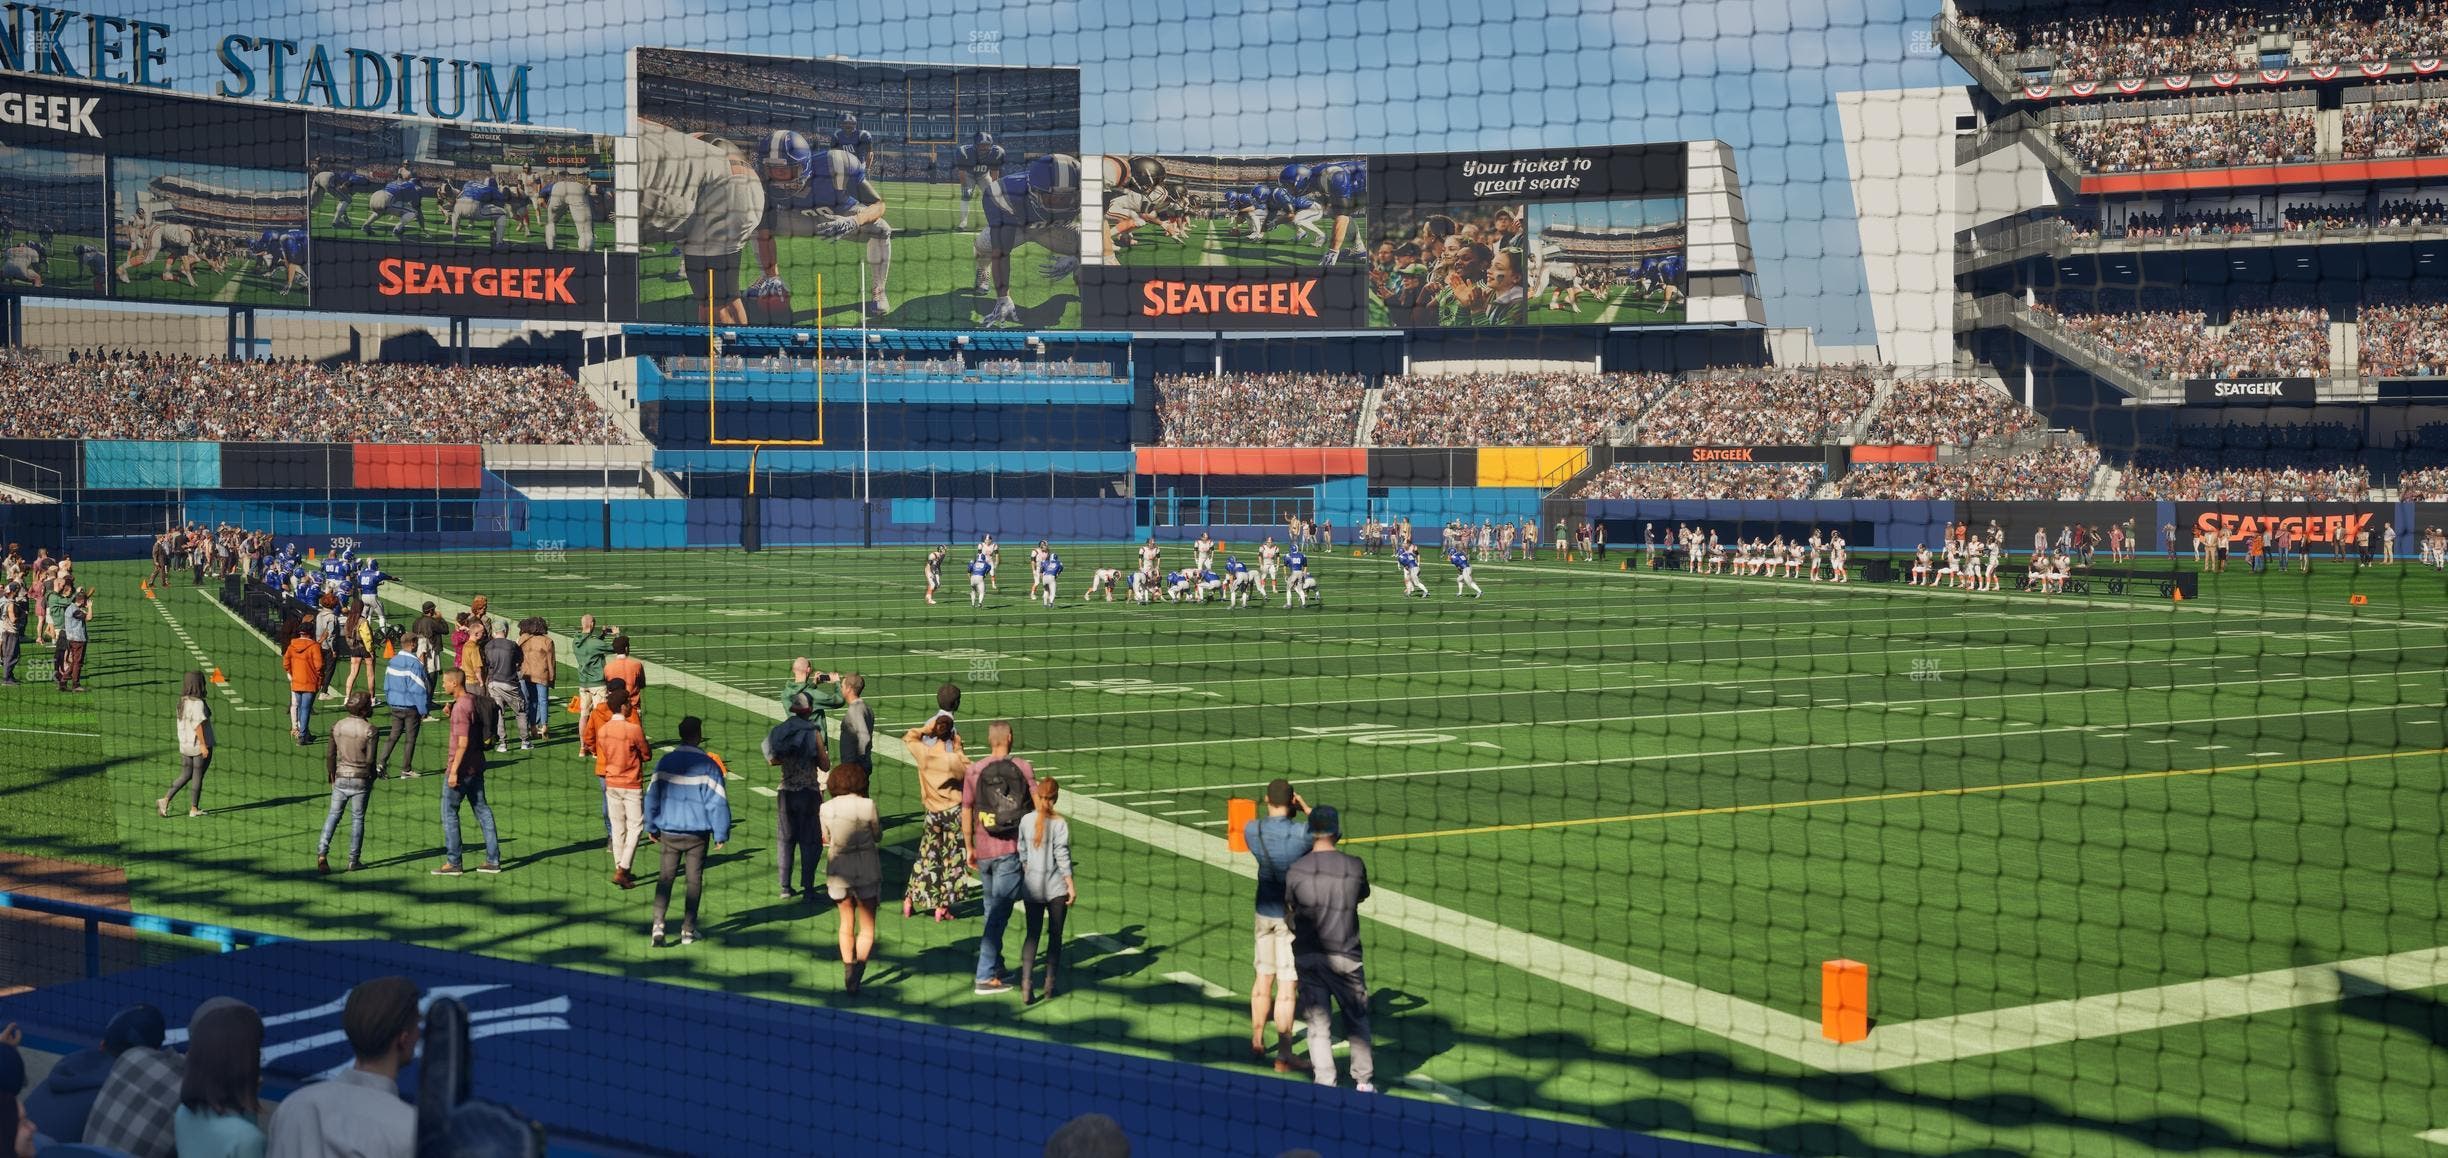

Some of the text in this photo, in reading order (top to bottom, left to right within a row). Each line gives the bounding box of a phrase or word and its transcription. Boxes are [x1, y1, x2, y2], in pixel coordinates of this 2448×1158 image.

[216, 34, 535, 124] STADIUM
[0, 92, 103, 139] GEEK
[547, 156, 588, 165] SEATGEEK
[1463, 156, 1592, 177] Your ticket to
[1474, 174, 1581, 196] great seats
[378, 257, 577, 304] SEATGEEK
[1143, 279, 1318, 317] SEATGEEK
[2215, 381, 2283, 396] SEATGEEK
[1692, 448, 1753, 462] SEATGEEK
